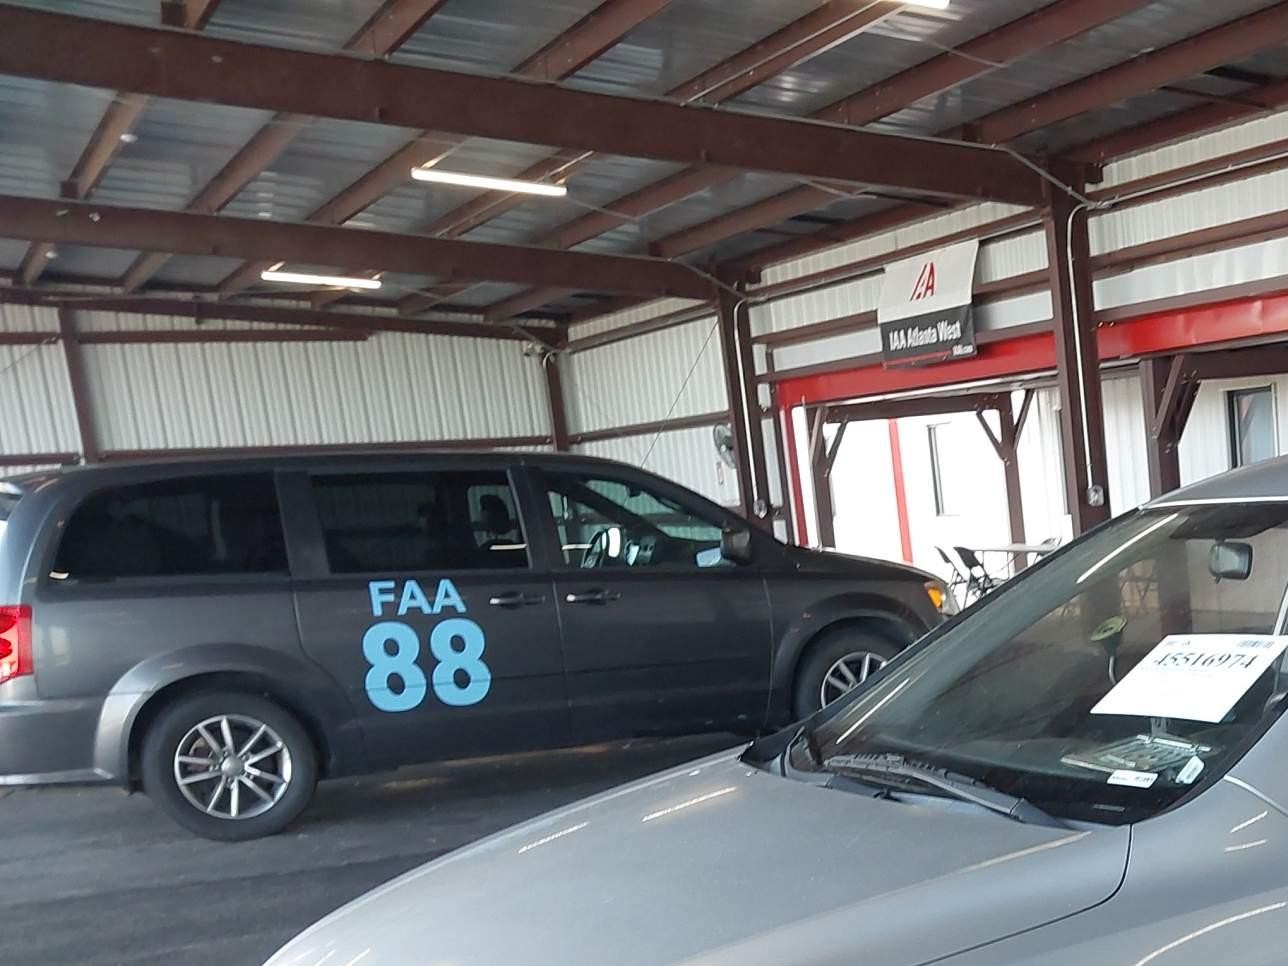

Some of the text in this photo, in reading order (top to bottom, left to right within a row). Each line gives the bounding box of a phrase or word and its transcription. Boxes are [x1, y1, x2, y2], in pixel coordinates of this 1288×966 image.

[889, 320, 961, 351] IAA Atlanta West
[368, 578, 467, 617] FAA
[362, 617, 492, 713] 88
[1153, 652, 1259, 669] 45516974
